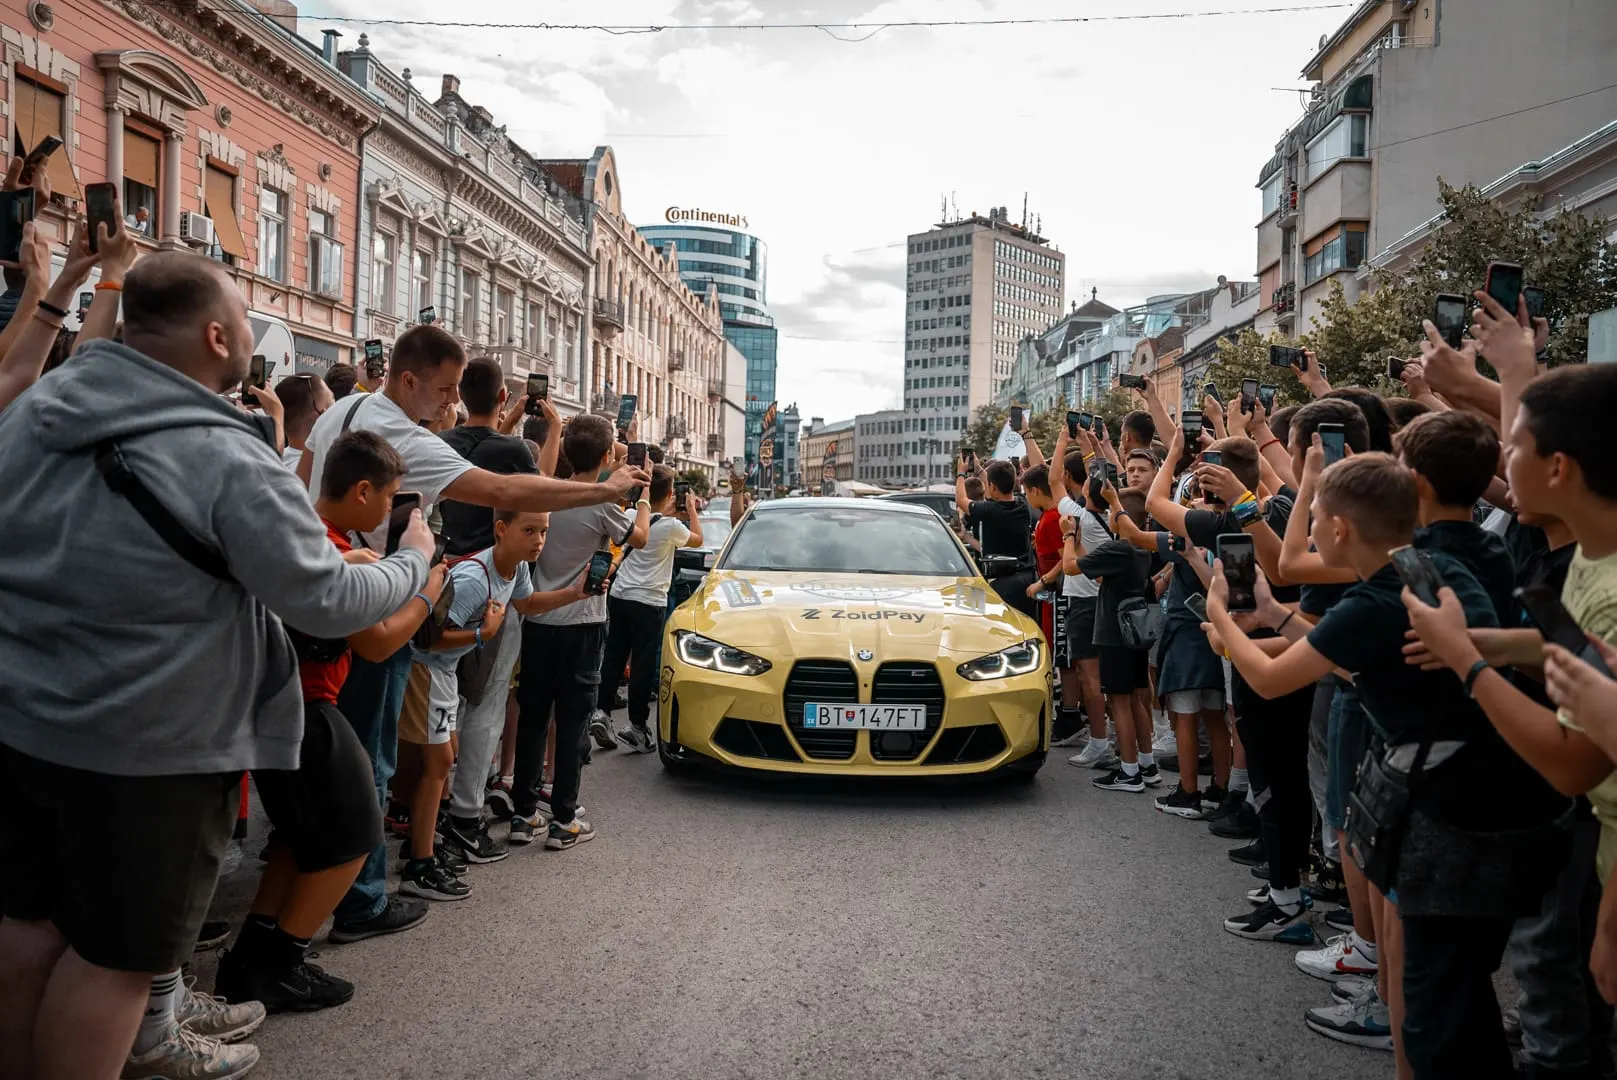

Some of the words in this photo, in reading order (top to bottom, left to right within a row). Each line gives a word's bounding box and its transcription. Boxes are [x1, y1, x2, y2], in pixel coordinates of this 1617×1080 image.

[665, 206, 740, 227] Continental
[831, 609, 926, 624] ZoidPay
[819, 706, 844, 726] BT
[859, 707, 922, 728] 147FT
